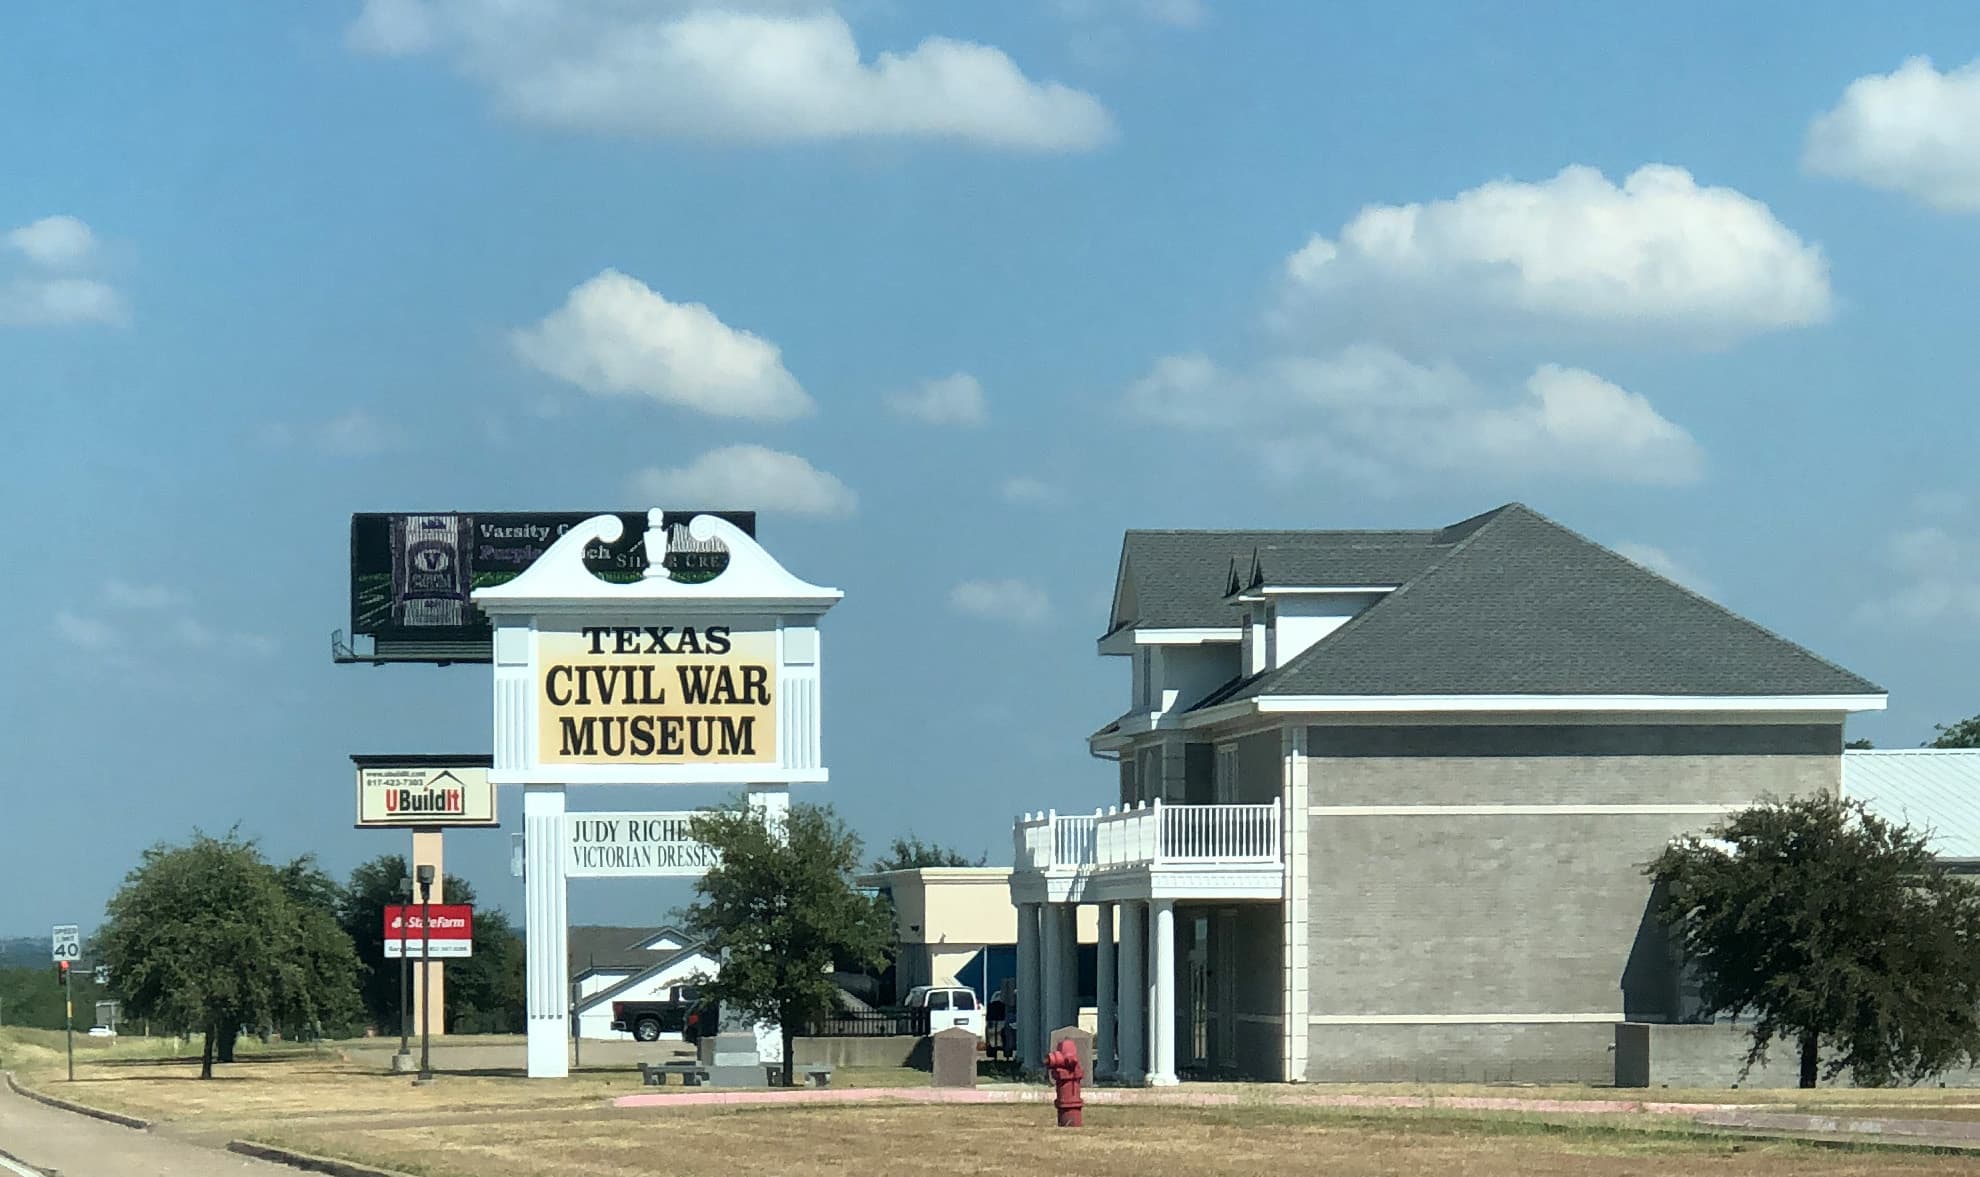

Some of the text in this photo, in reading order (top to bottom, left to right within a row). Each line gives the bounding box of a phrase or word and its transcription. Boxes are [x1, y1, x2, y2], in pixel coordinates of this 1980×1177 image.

[480, 524, 551, 541] Varsity
[582, 626, 731, 655] TEXAS
[545, 665, 771, 706] CIVIL WAR
[559, 715, 756, 756] MUSEUM
[386, 786, 460, 812] UBuildIt
[573, 820, 620, 842] JUDY
[573, 844, 718, 868] VICTORIAN DRESSES
[54, 943, 79, 957] 40
